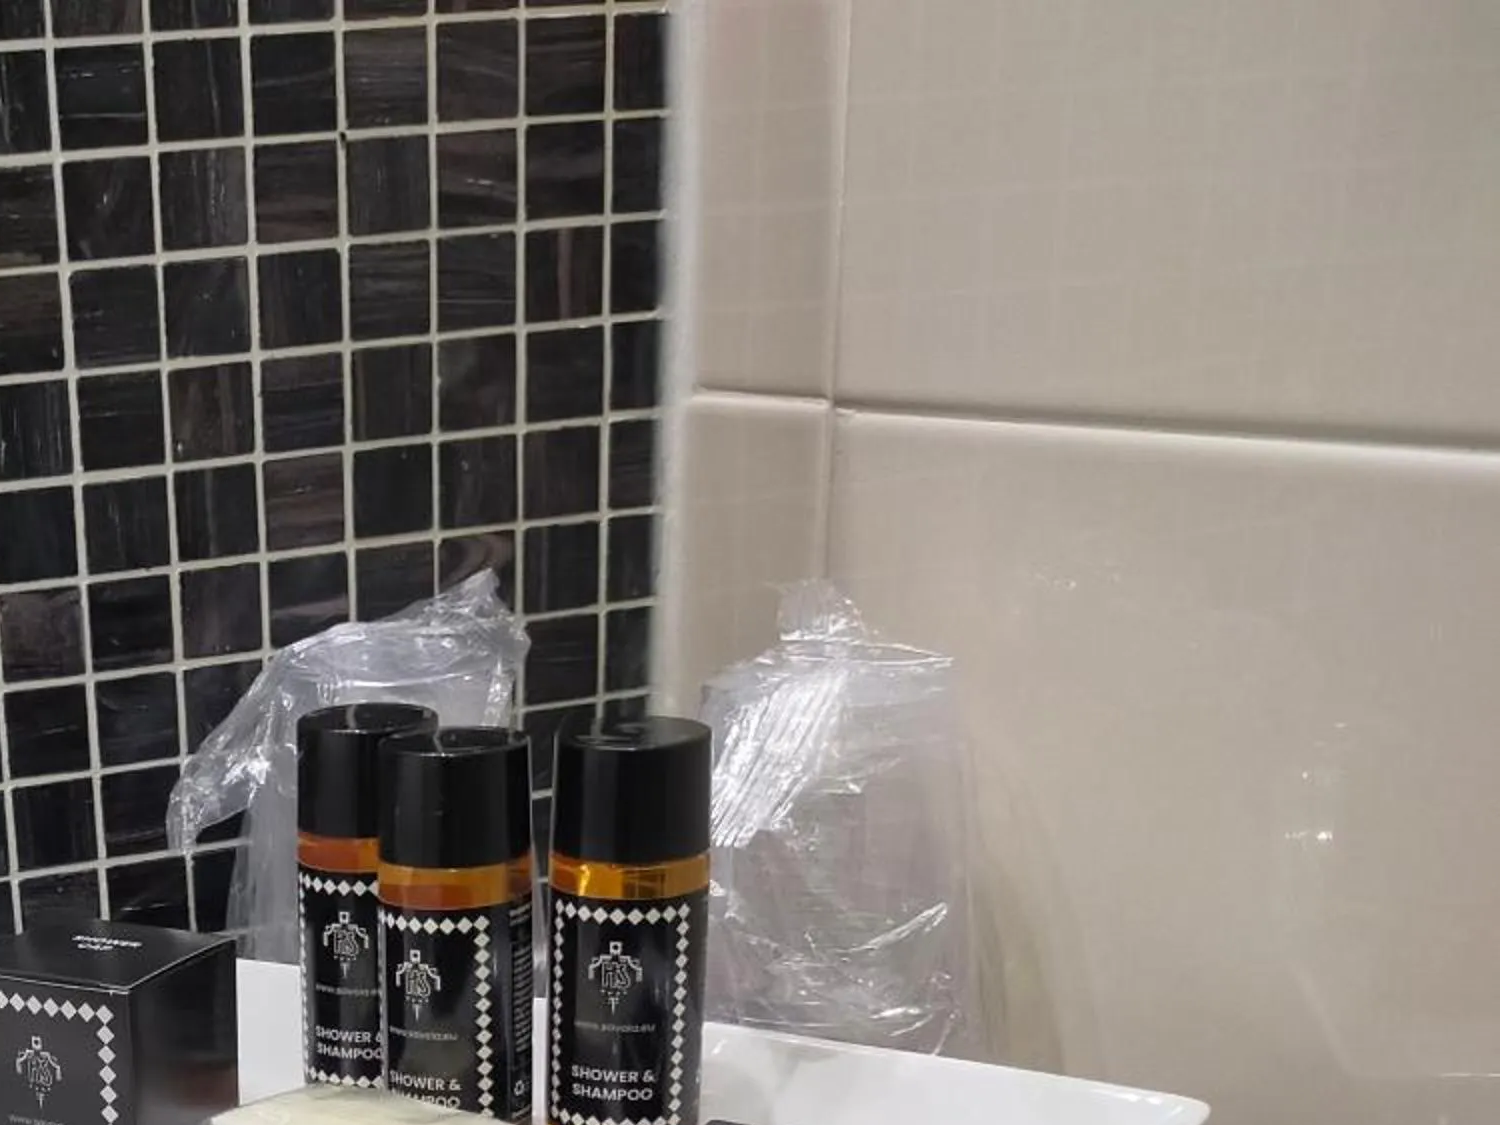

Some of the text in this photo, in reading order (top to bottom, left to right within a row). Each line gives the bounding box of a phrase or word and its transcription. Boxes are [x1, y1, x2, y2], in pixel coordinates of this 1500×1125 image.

[315, 1025, 371, 1043] SHOWER
[389, 1069, 461, 1091] SHOWER &
[571, 1064, 656, 1083] SHOWER &
[571, 1082, 653, 1102] SHAMPOO
